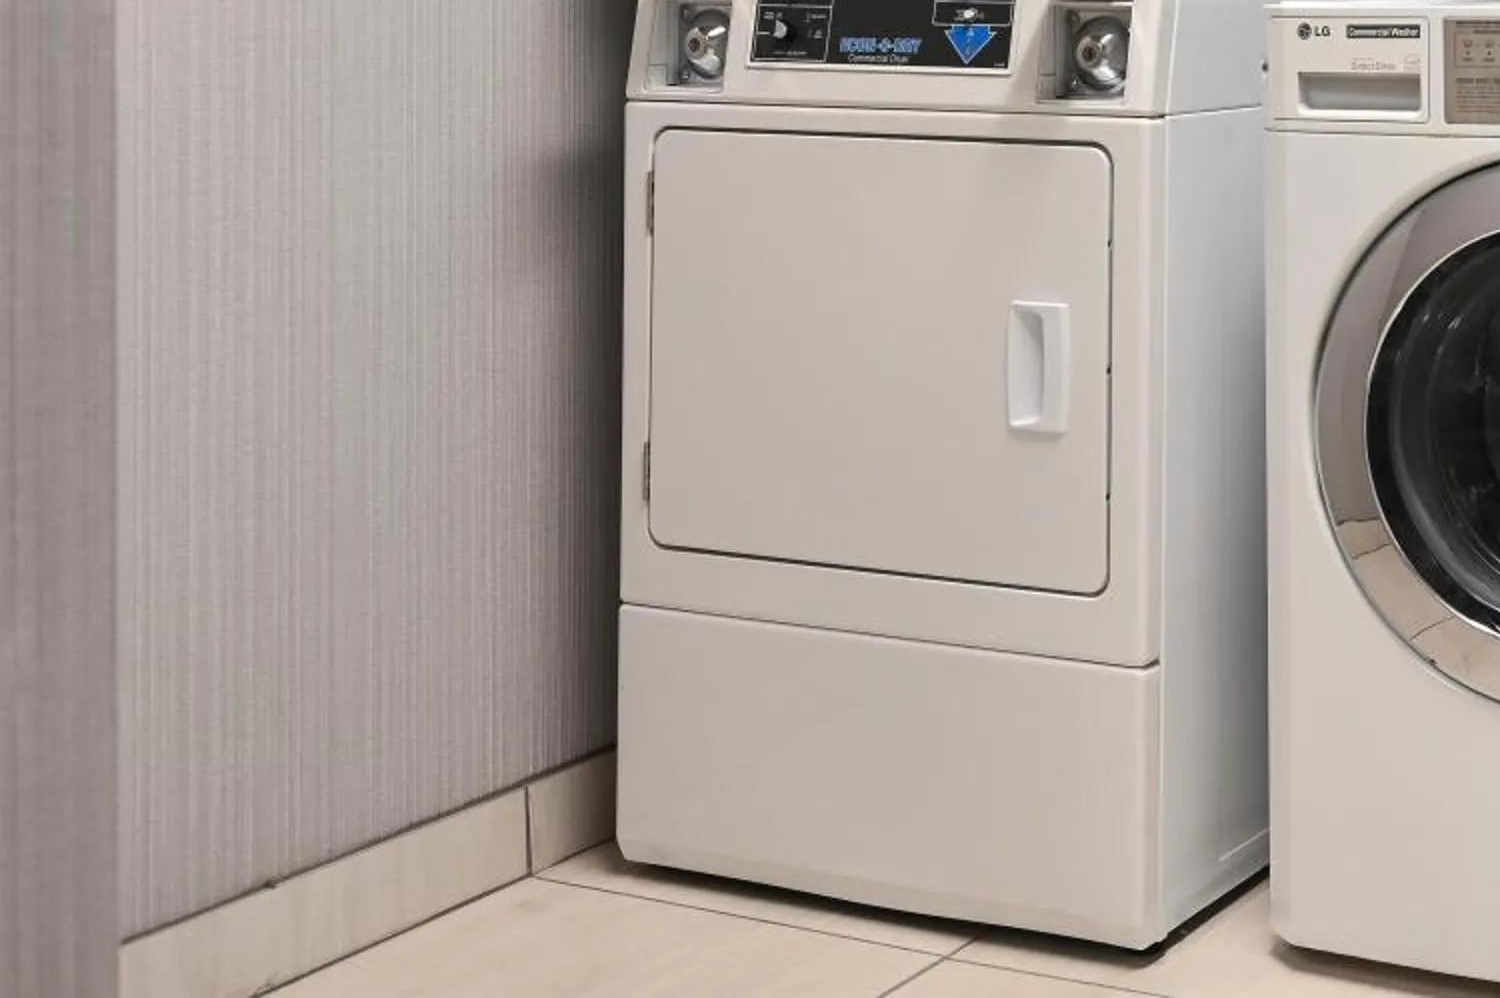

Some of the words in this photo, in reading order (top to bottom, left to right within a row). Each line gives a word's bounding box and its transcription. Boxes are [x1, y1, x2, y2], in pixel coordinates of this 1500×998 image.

[1313, 26, 1331, 37] LG
[1348, 27, 1389, 37] Commercial
[1390, 27, 1419, 37] Washer
